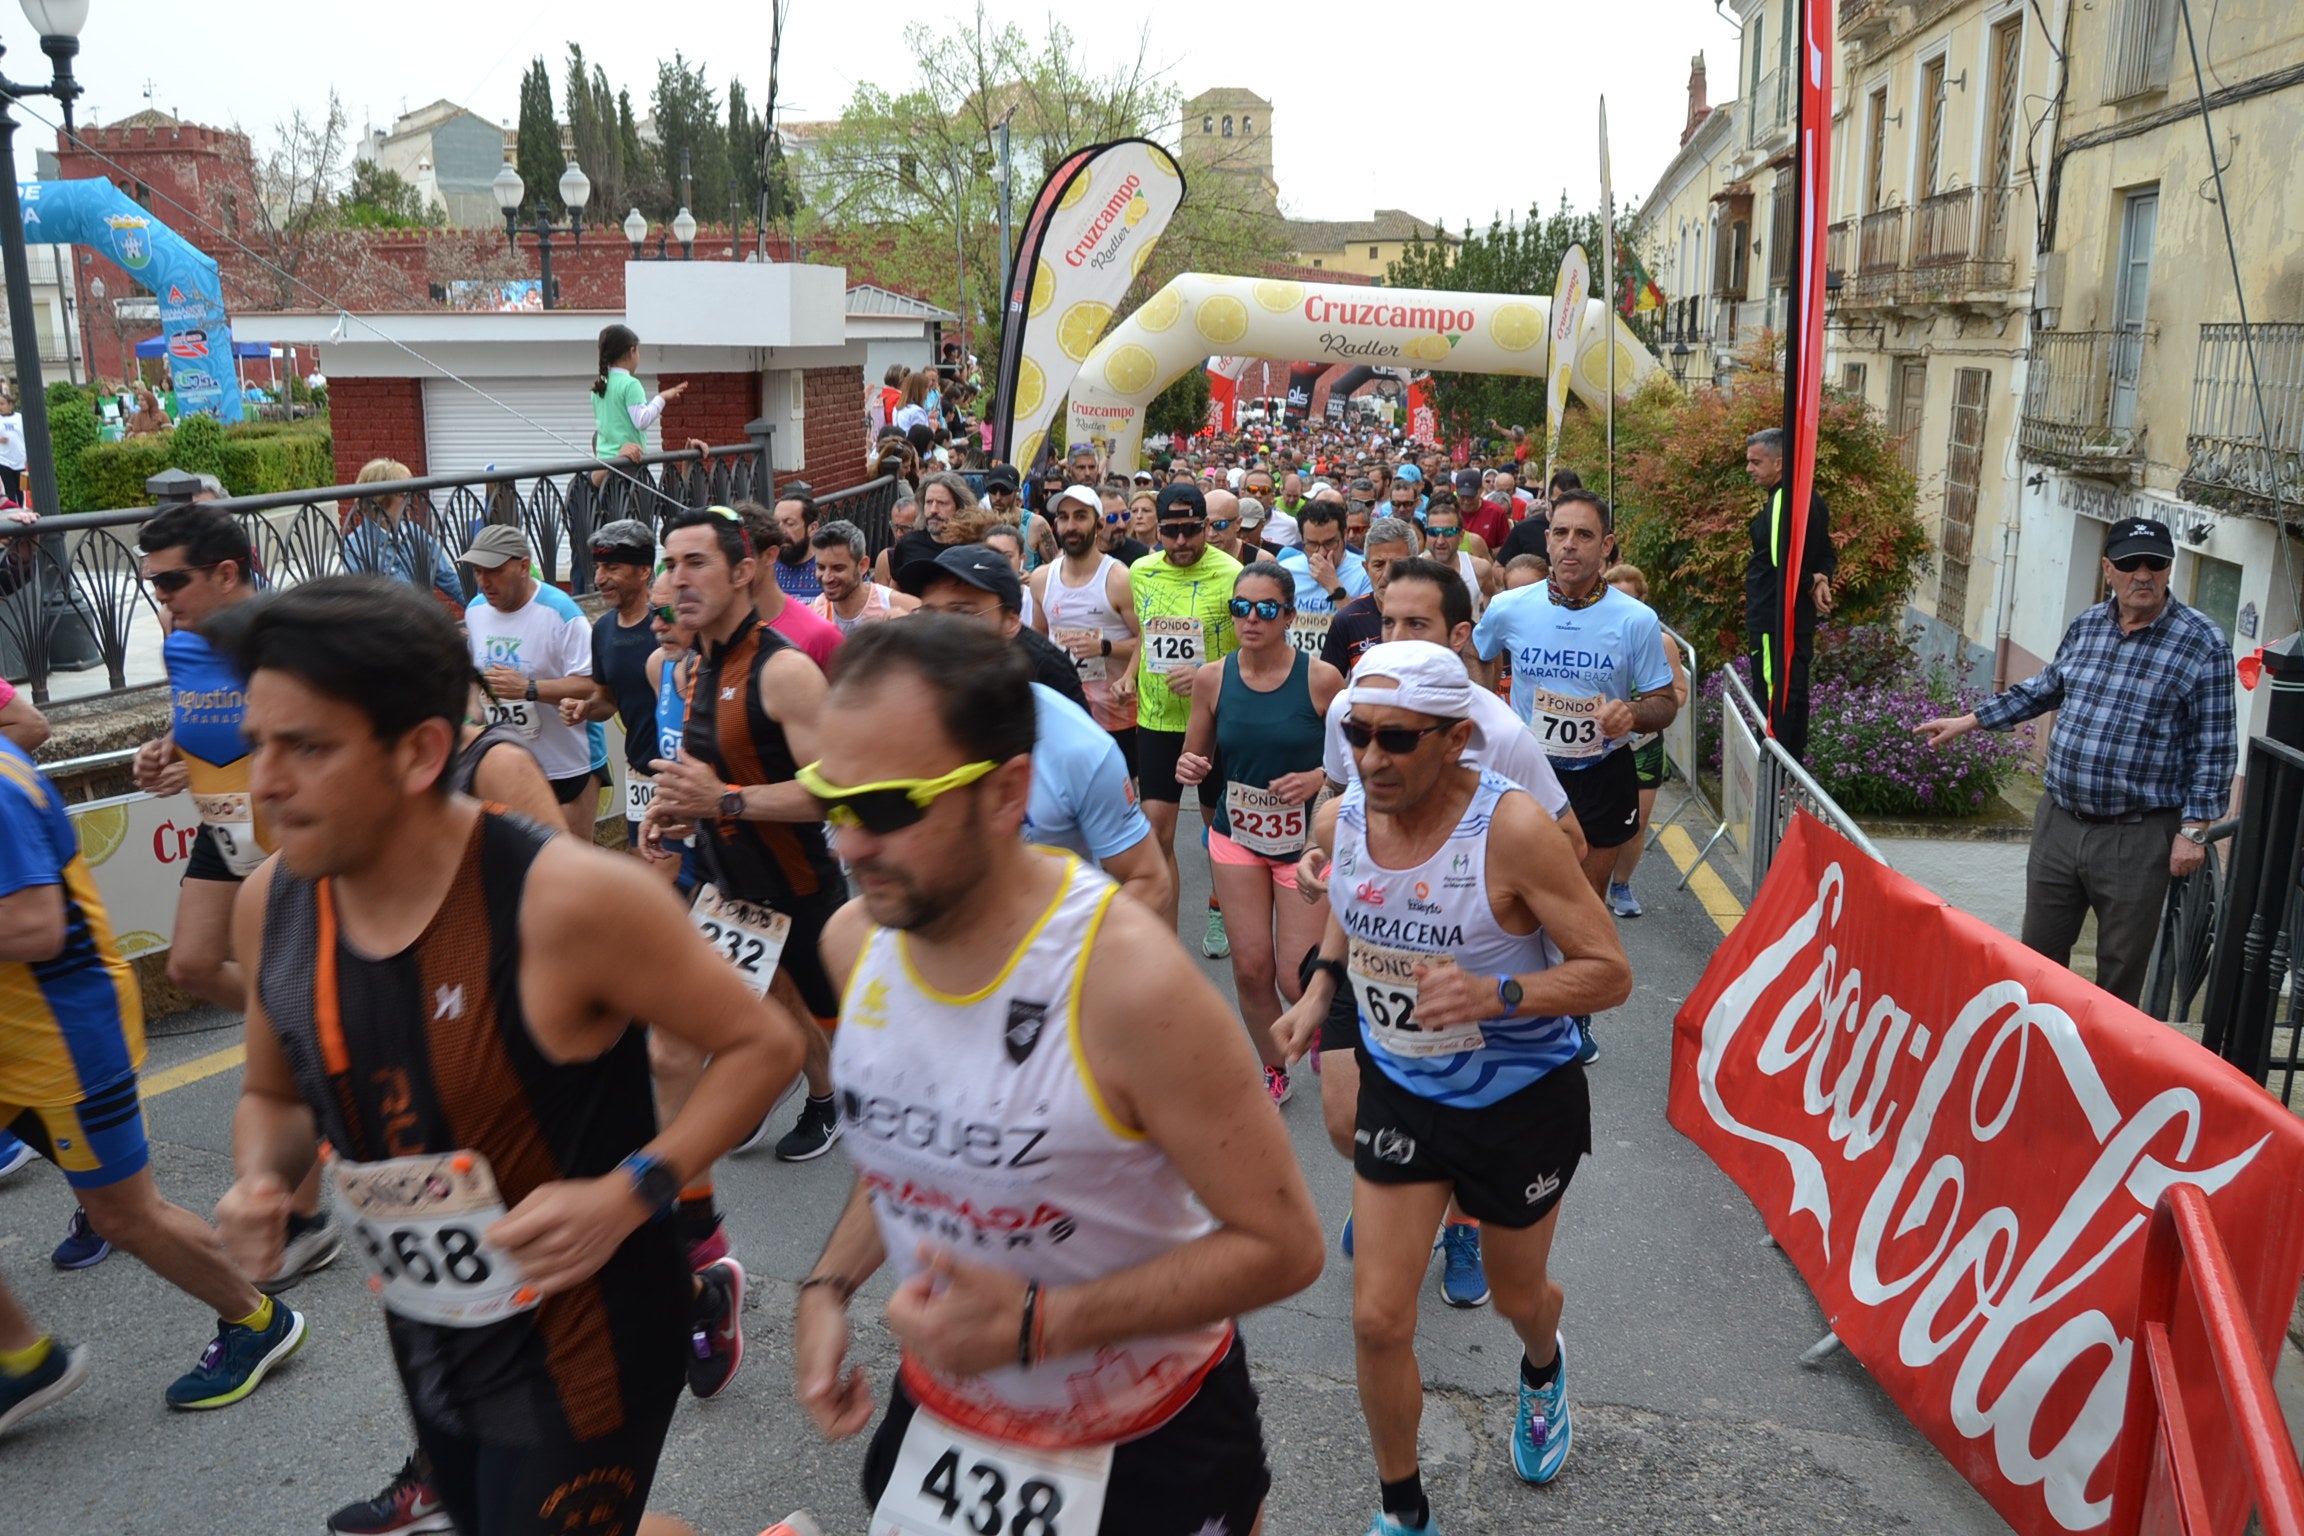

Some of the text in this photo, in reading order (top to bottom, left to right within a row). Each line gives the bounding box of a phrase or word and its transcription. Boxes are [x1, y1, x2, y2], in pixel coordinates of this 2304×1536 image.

[1064, 173, 1141, 268] Cruzcampo
[1091, 226, 1130, 270] Radler
[1304, 295, 1475, 335] Cruzcampo
[1557, 268, 1578, 340] Cruzcampo
[1319, 331, 1400, 357] Radler
[1071, 400, 1135, 419] Cruzcampo
[1075, 416, 1106, 431] Radler
[1298, 597, 1337, 612] MEDI
[1155, 620, 1190, 631] FONDO
[1152, 636, 1195, 660] 126
[1520, 665, 1580, 680] MARATÓN
[1584, 672, 1613, 682] BAZA
[1549, 697, 1594, 713] FONDO
[1543, 716, 1596, 744] 703
[1230, 808, 1302, 839] 2235
[1344, 908, 1465, 946] MARACENA
[1361, 954, 1414, 977] FOND
[1366, 985, 1443, 1032] 62
[1524, 1168, 1561, 1204] als
[1697, 861, 2273, 1532] Coca-Cola
[919, 1446, 1063, 1536] 438
